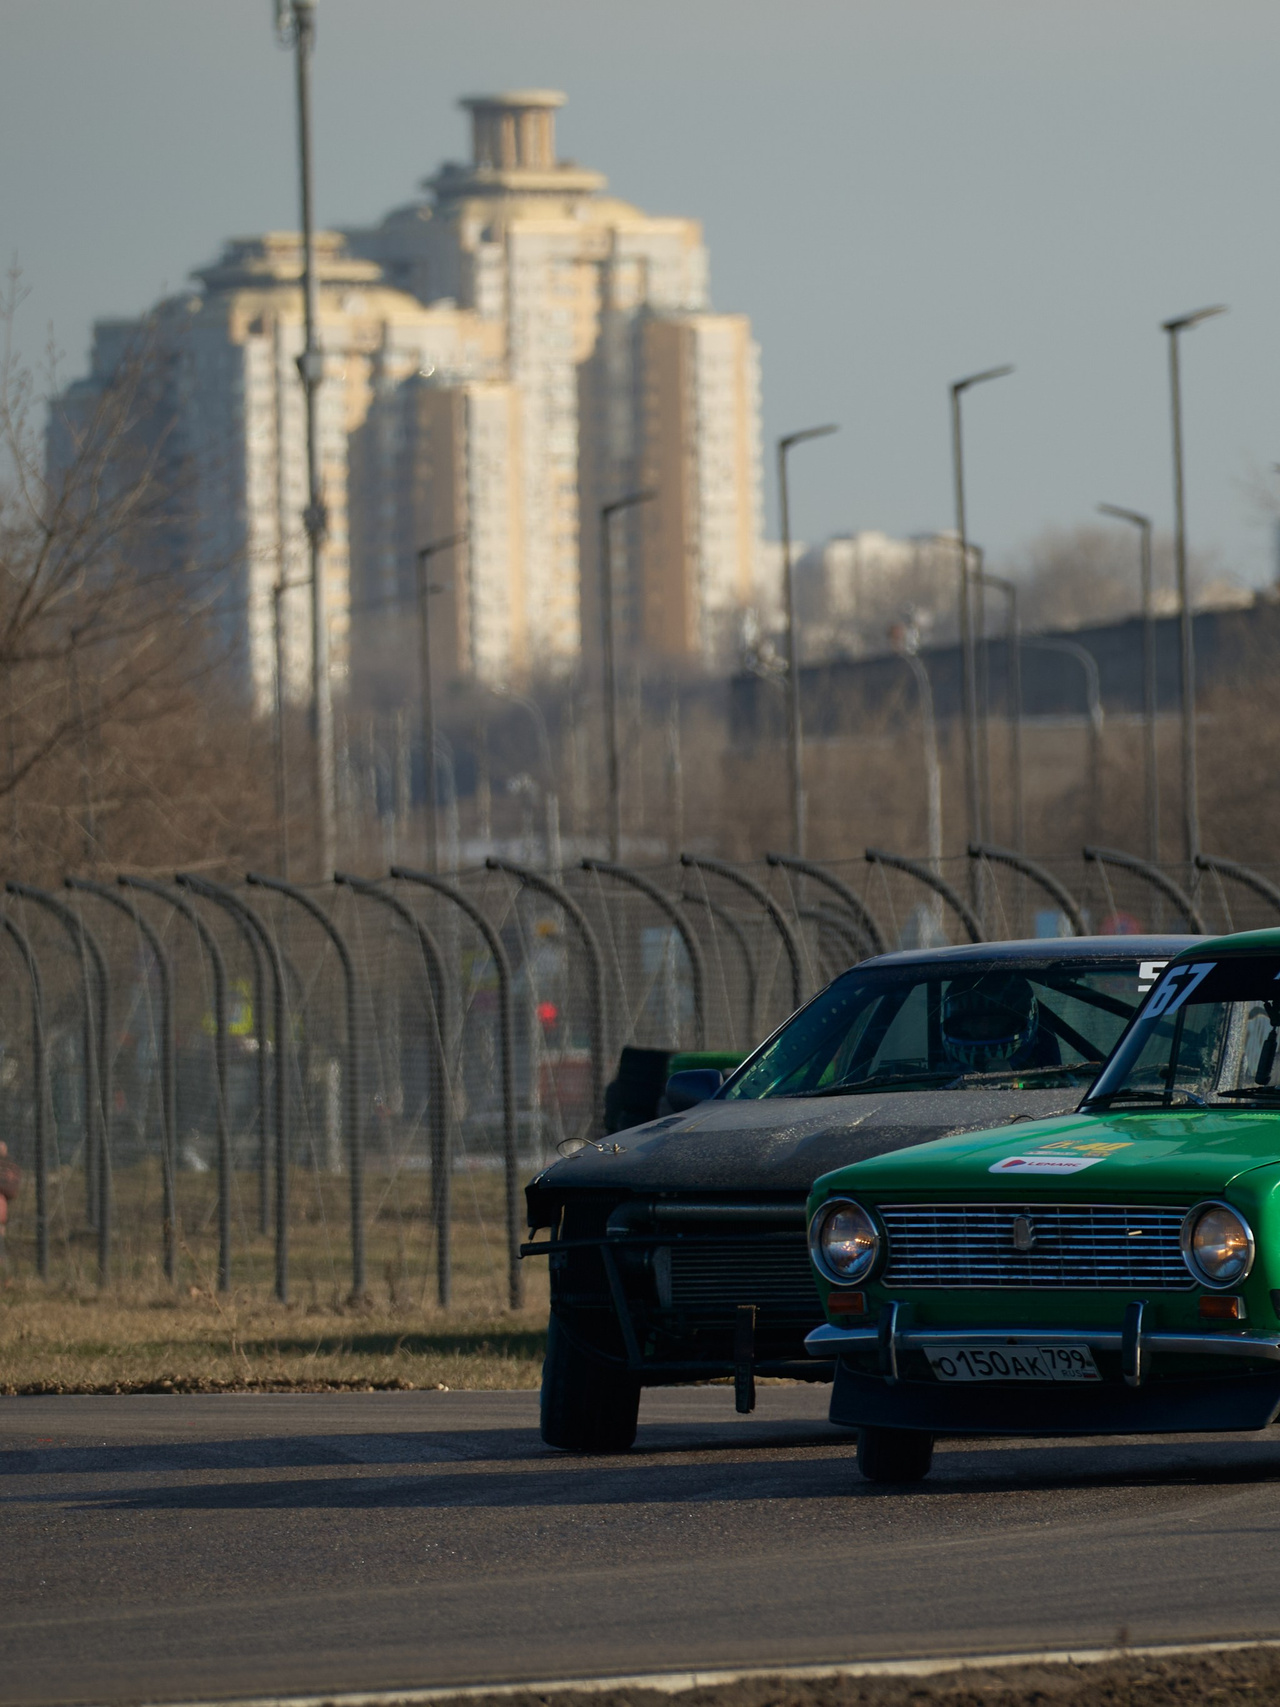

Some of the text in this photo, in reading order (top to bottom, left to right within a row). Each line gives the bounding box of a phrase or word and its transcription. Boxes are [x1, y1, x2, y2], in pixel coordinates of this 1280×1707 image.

[1141, 962, 1218, 1020] 67
[1041, 1349, 1086, 1369] 799
[1062, 1369, 1083, 1378] RUS
